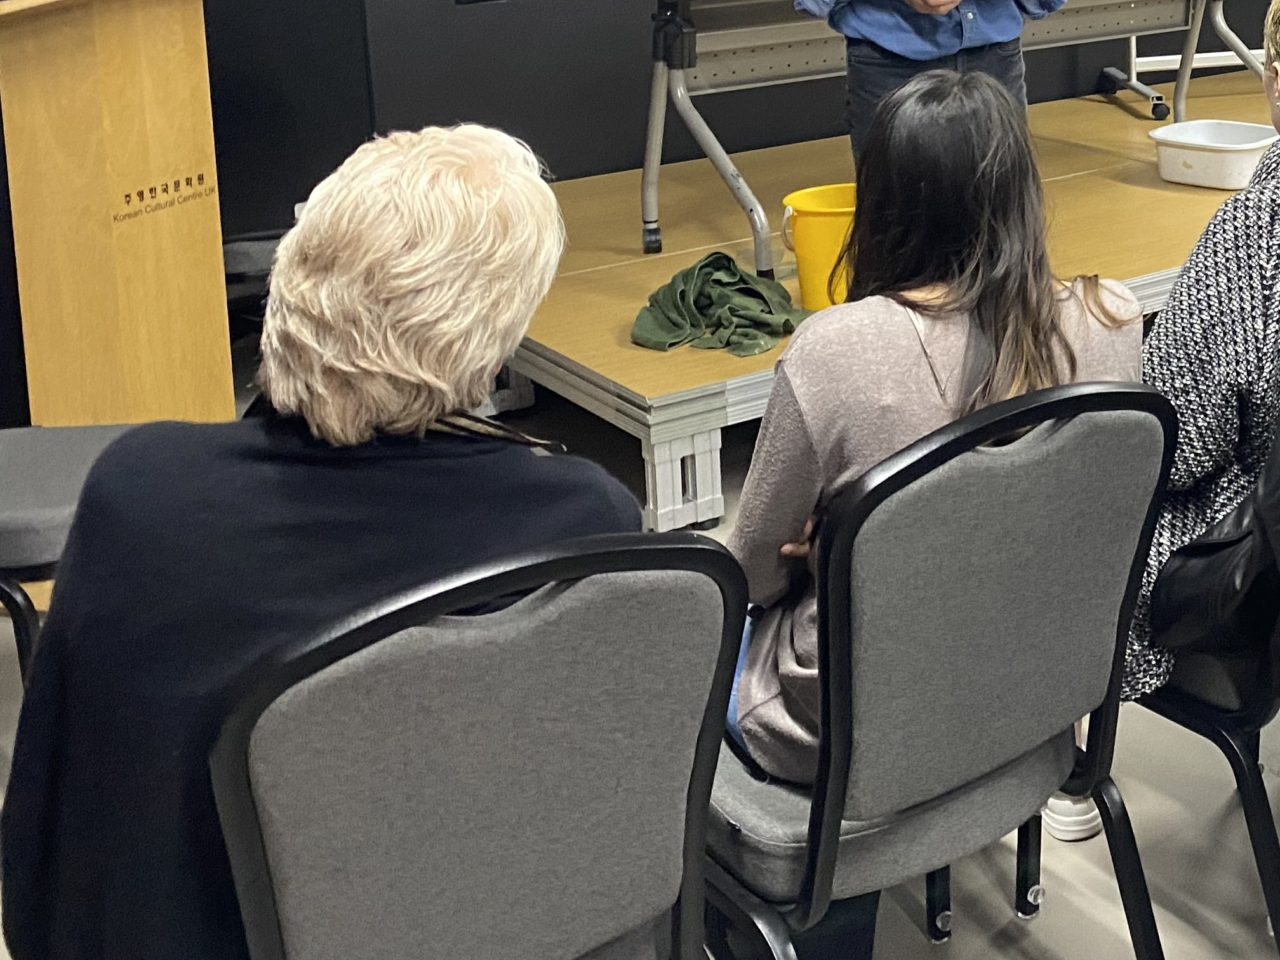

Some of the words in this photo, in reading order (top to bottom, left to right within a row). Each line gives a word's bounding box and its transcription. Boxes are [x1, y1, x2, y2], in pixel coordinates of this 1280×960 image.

[112, 208, 143, 223] Korean
[144, 198, 176, 214] Cultural
[176, 191, 203, 205] Centre
[204, 186, 216, 197] UK
